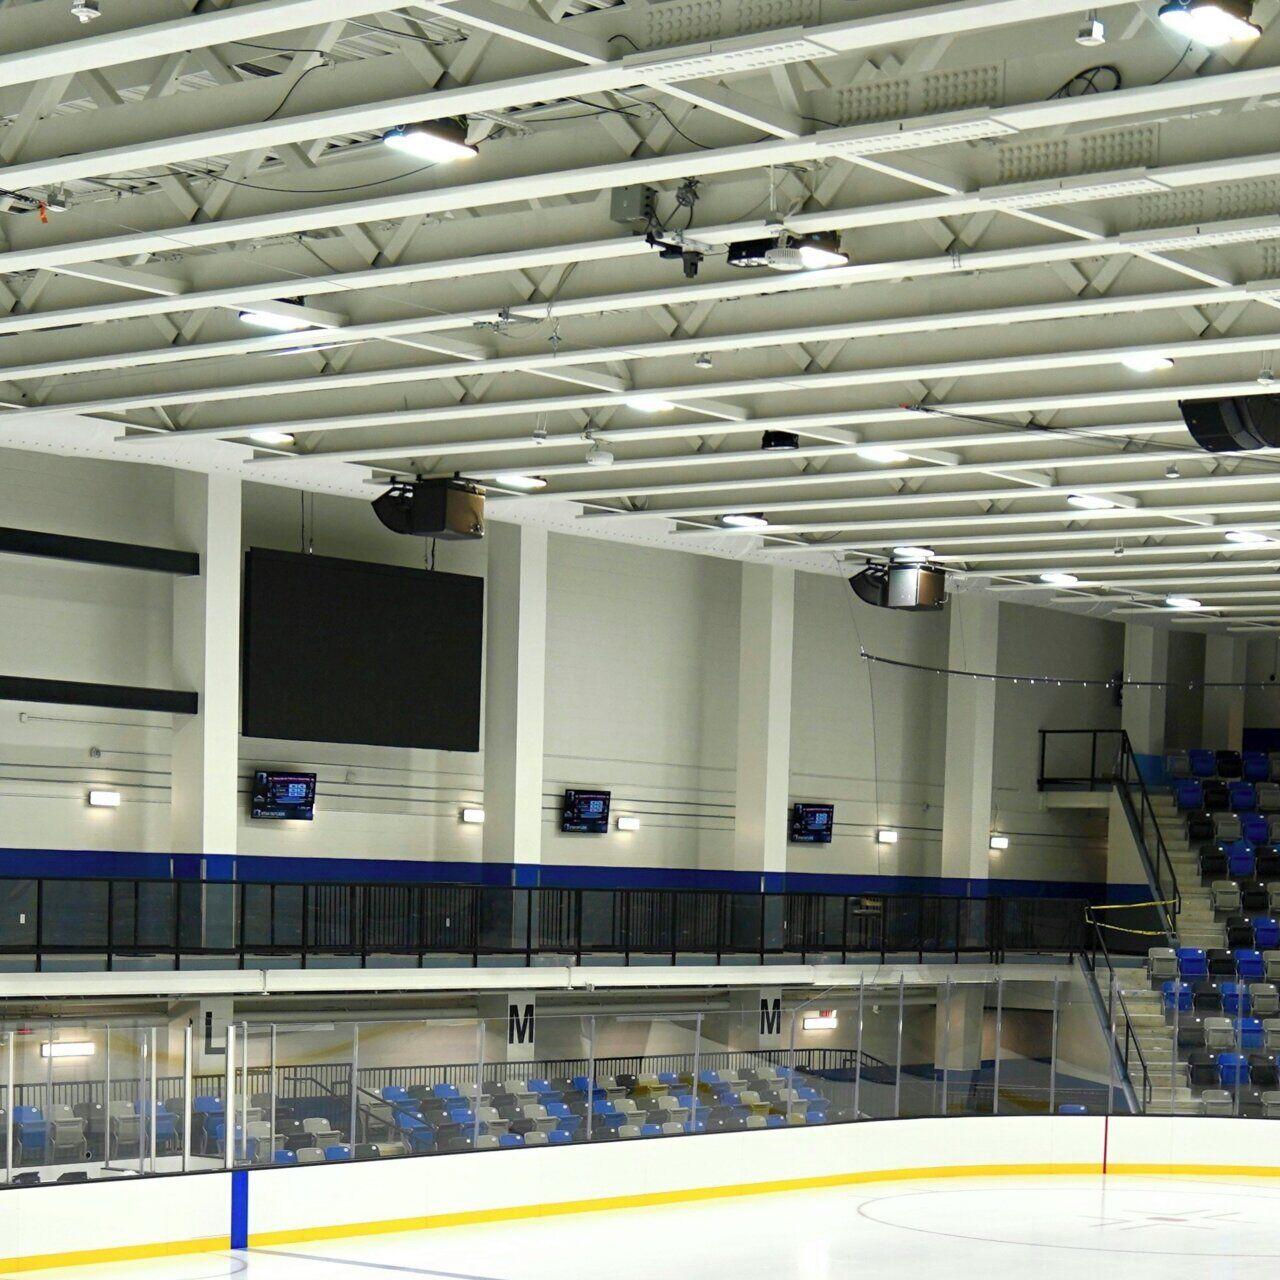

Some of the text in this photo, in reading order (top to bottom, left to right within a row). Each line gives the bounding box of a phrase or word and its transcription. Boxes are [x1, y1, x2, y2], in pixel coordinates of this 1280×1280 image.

[204, 1011, 226, 1055] L
[509, 1004, 534, 1044] M
[760, 998, 781, 1034] M
